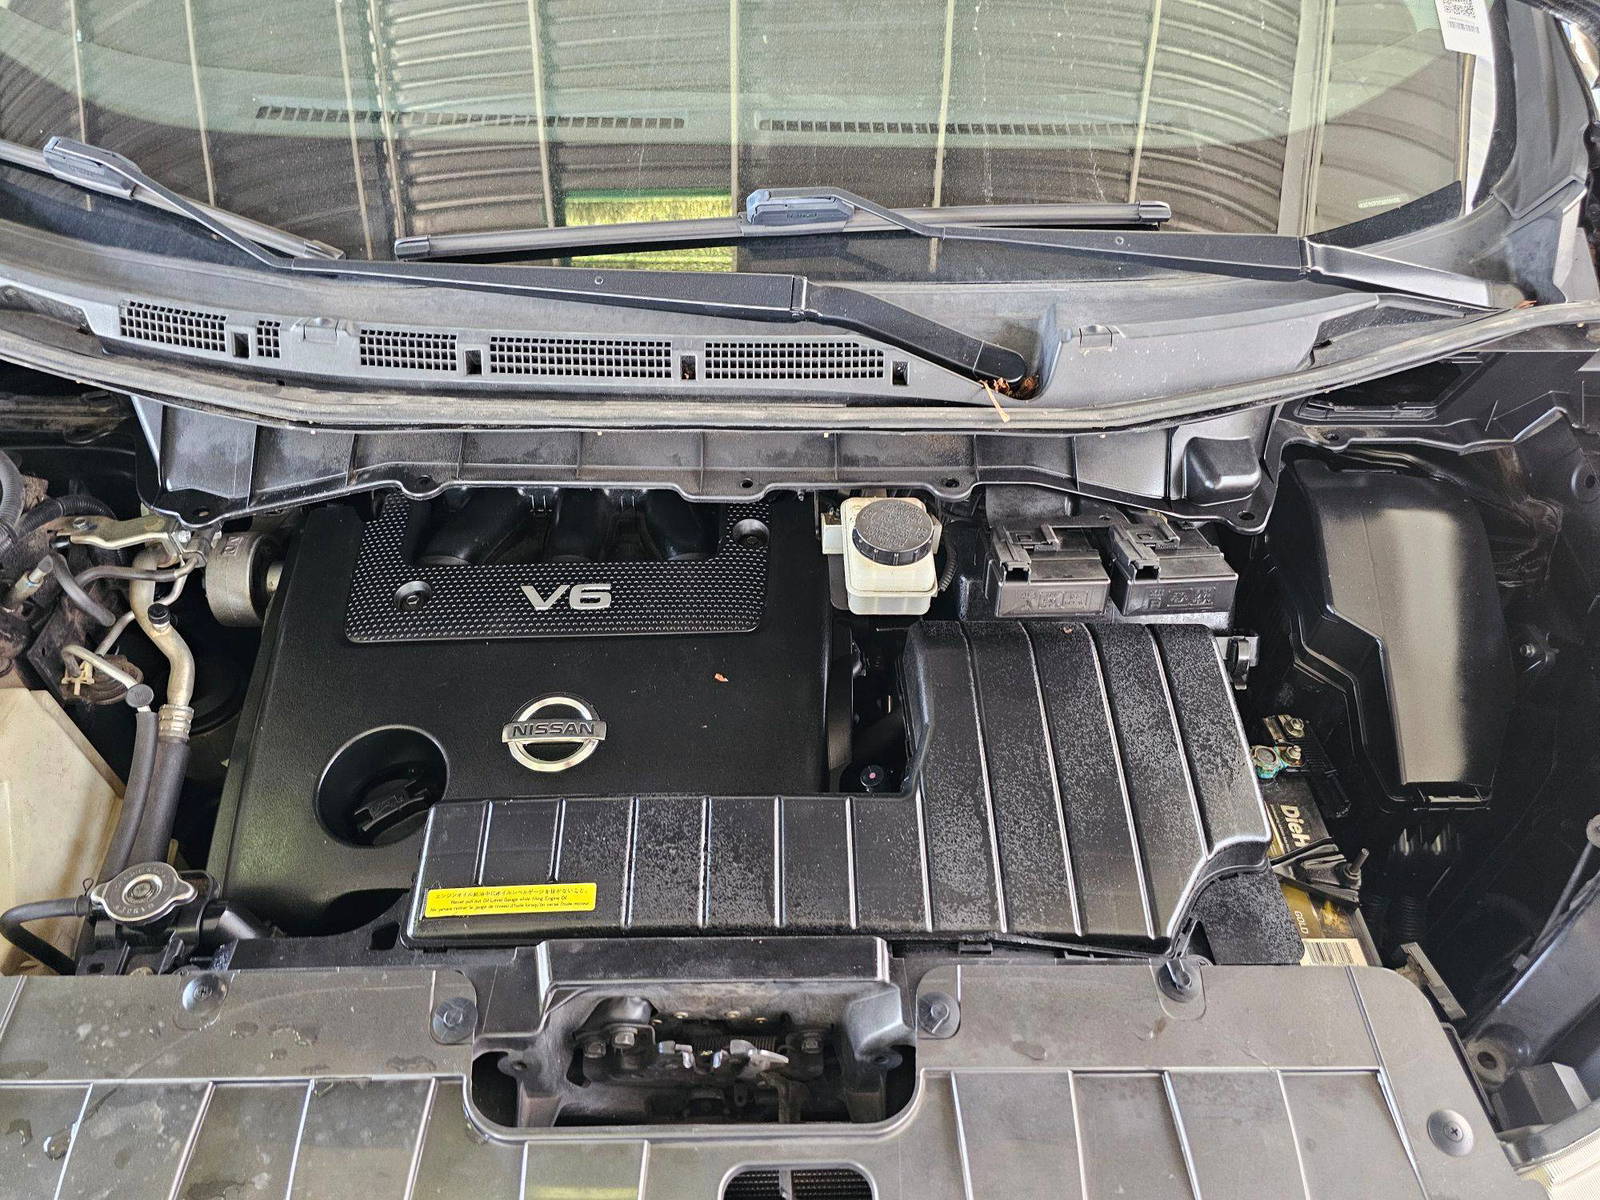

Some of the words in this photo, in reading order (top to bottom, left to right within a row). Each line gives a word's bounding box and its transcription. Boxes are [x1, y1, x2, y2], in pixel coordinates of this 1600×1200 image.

[520, 583, 612, 611] V6
[512, 721, 595, 737] NISSAN
[1279, 804, 1311, 848] DieH
[1294, 910, 1309, 934] GOLD
